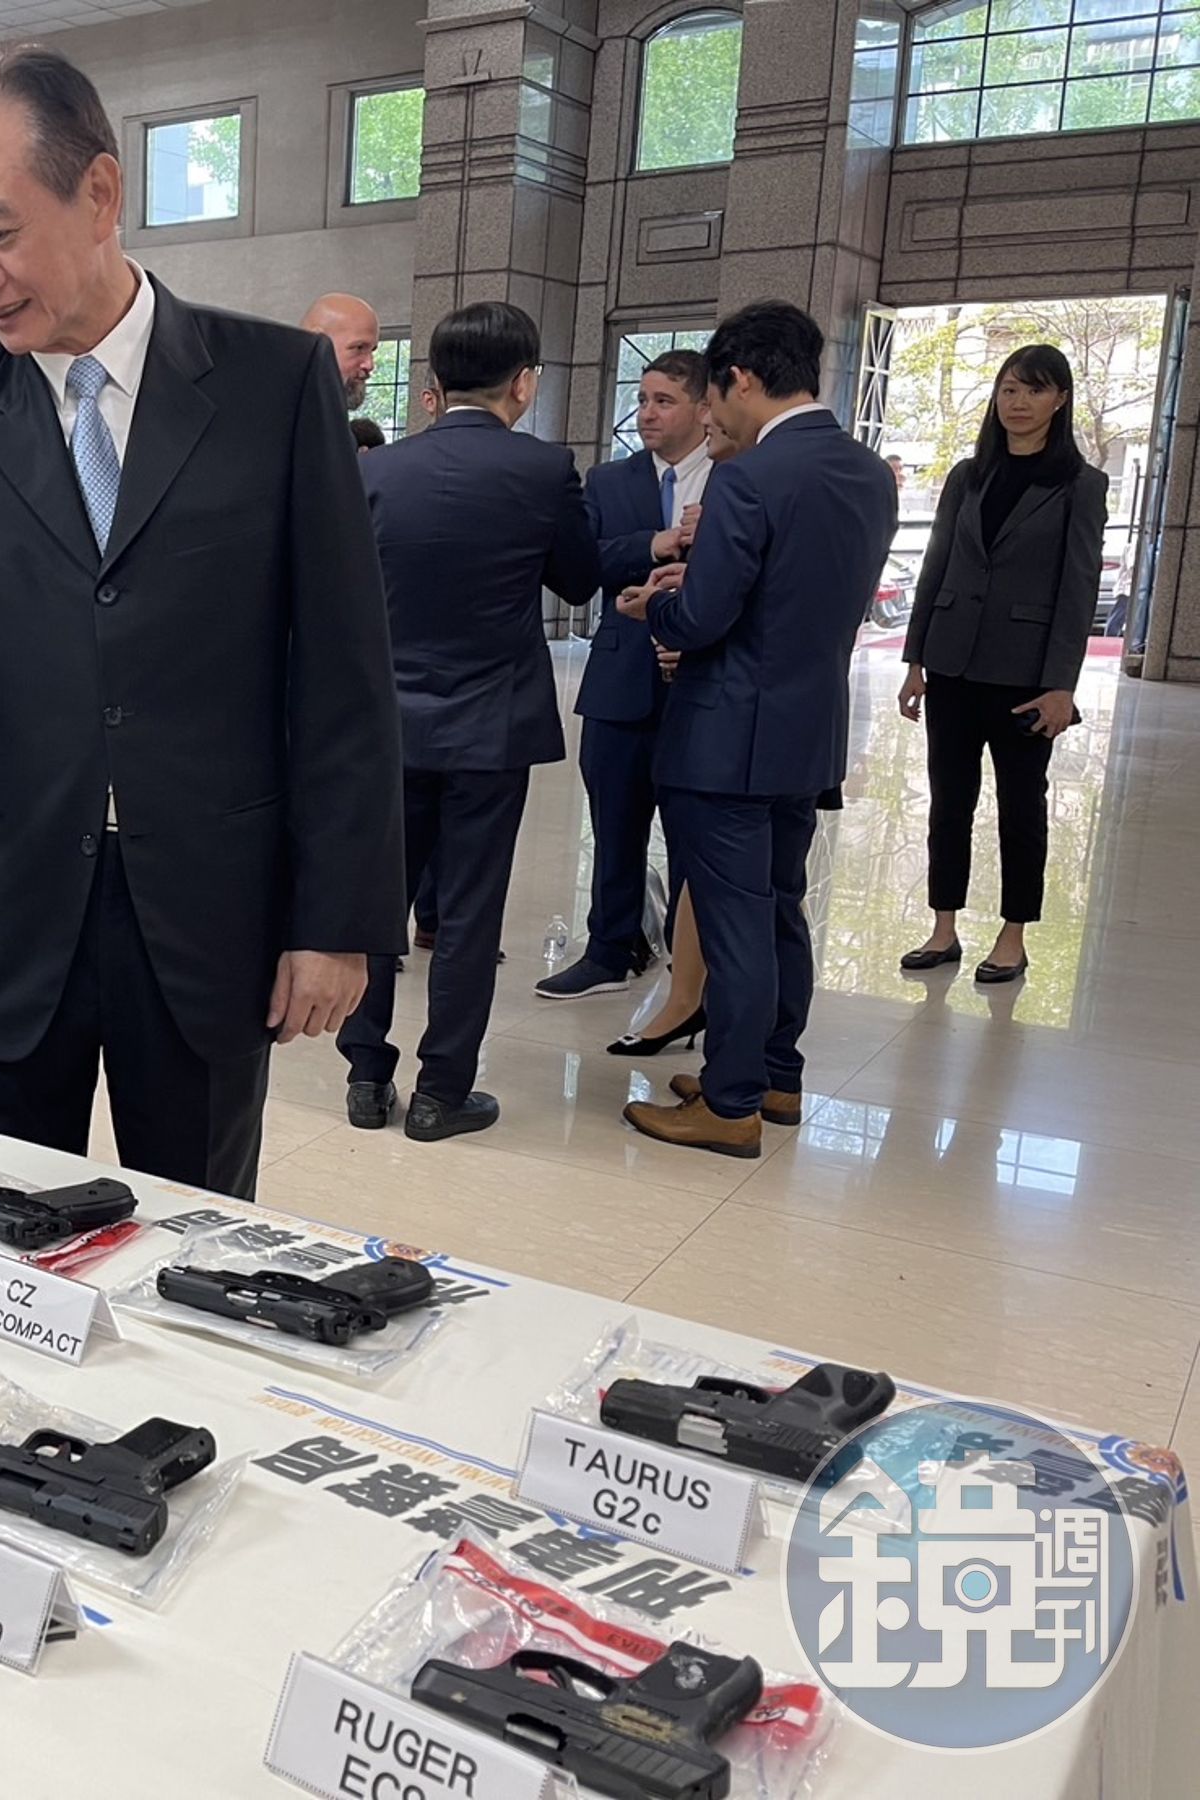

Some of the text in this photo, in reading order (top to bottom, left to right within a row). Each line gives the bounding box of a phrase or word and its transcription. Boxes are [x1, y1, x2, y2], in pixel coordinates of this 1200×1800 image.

[6, 1278, 38, 1308] CZ
[564, 1437, 712, 1510] TAURUS
[592, 1487, 663, 1536] G2c
[333, 1697, 478, 1799] RUGER
